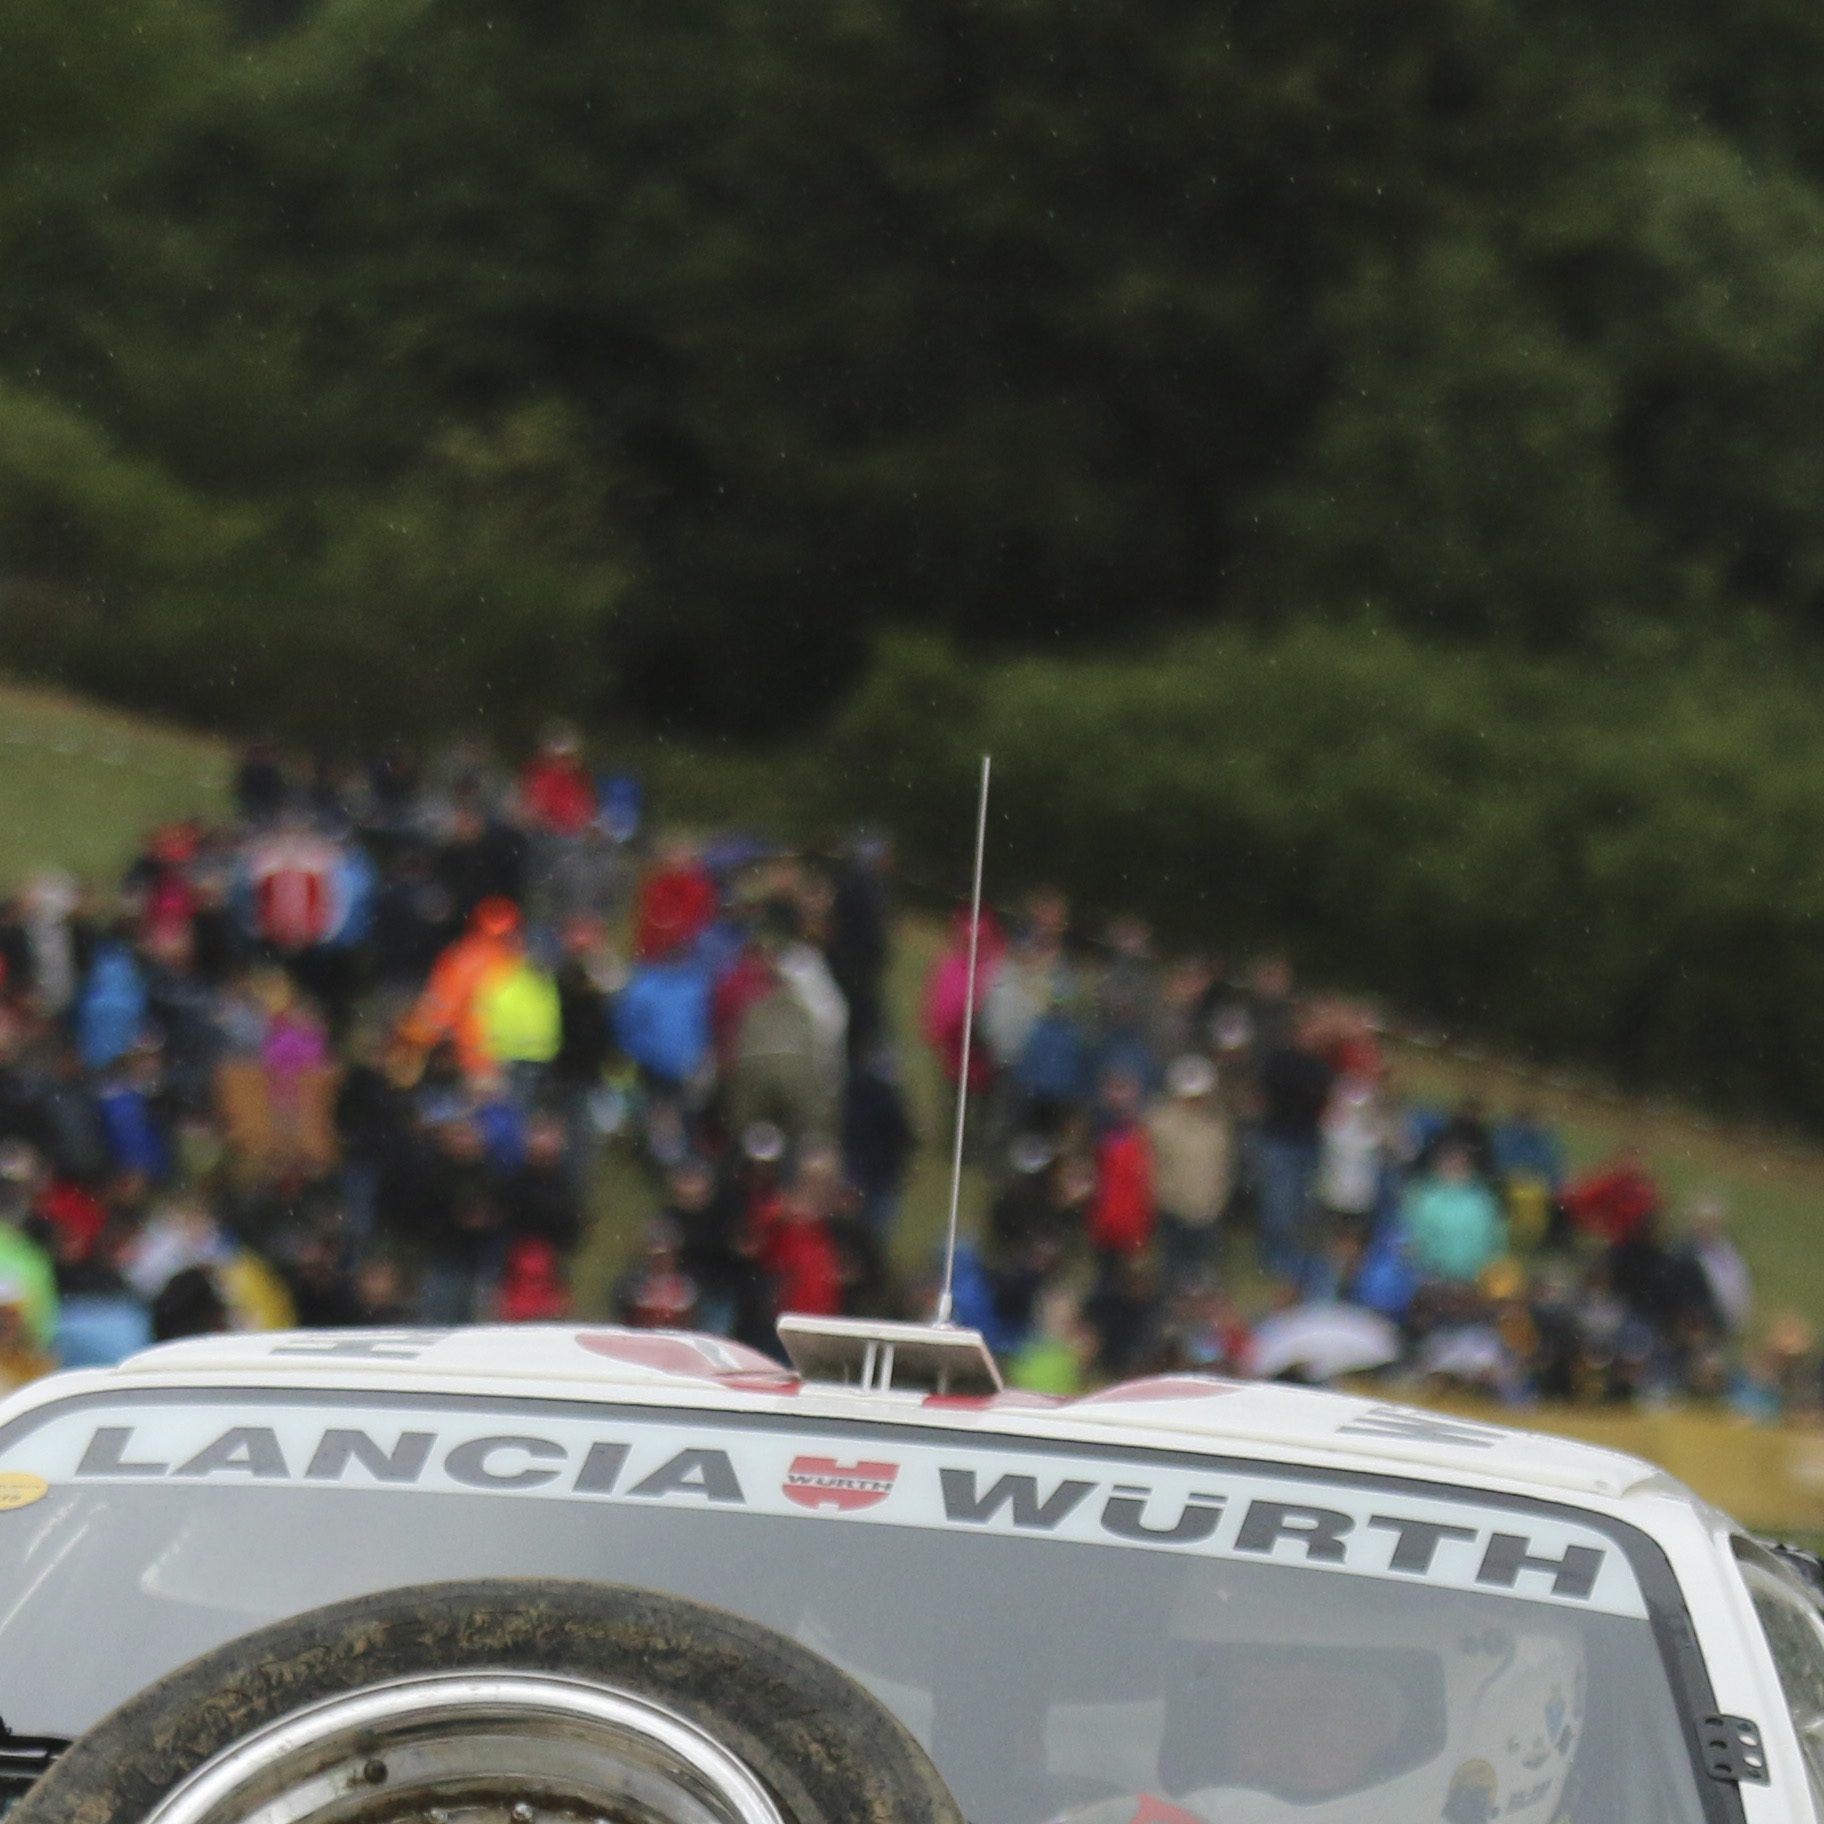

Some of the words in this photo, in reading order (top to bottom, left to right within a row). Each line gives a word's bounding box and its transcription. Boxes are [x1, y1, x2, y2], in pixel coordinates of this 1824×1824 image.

[74, 1426, 747, 1505] LANCIA
[787, 1474, 893, 1492] WÜRTH
[936, 1467, 1607, 1600] WÜRTH
